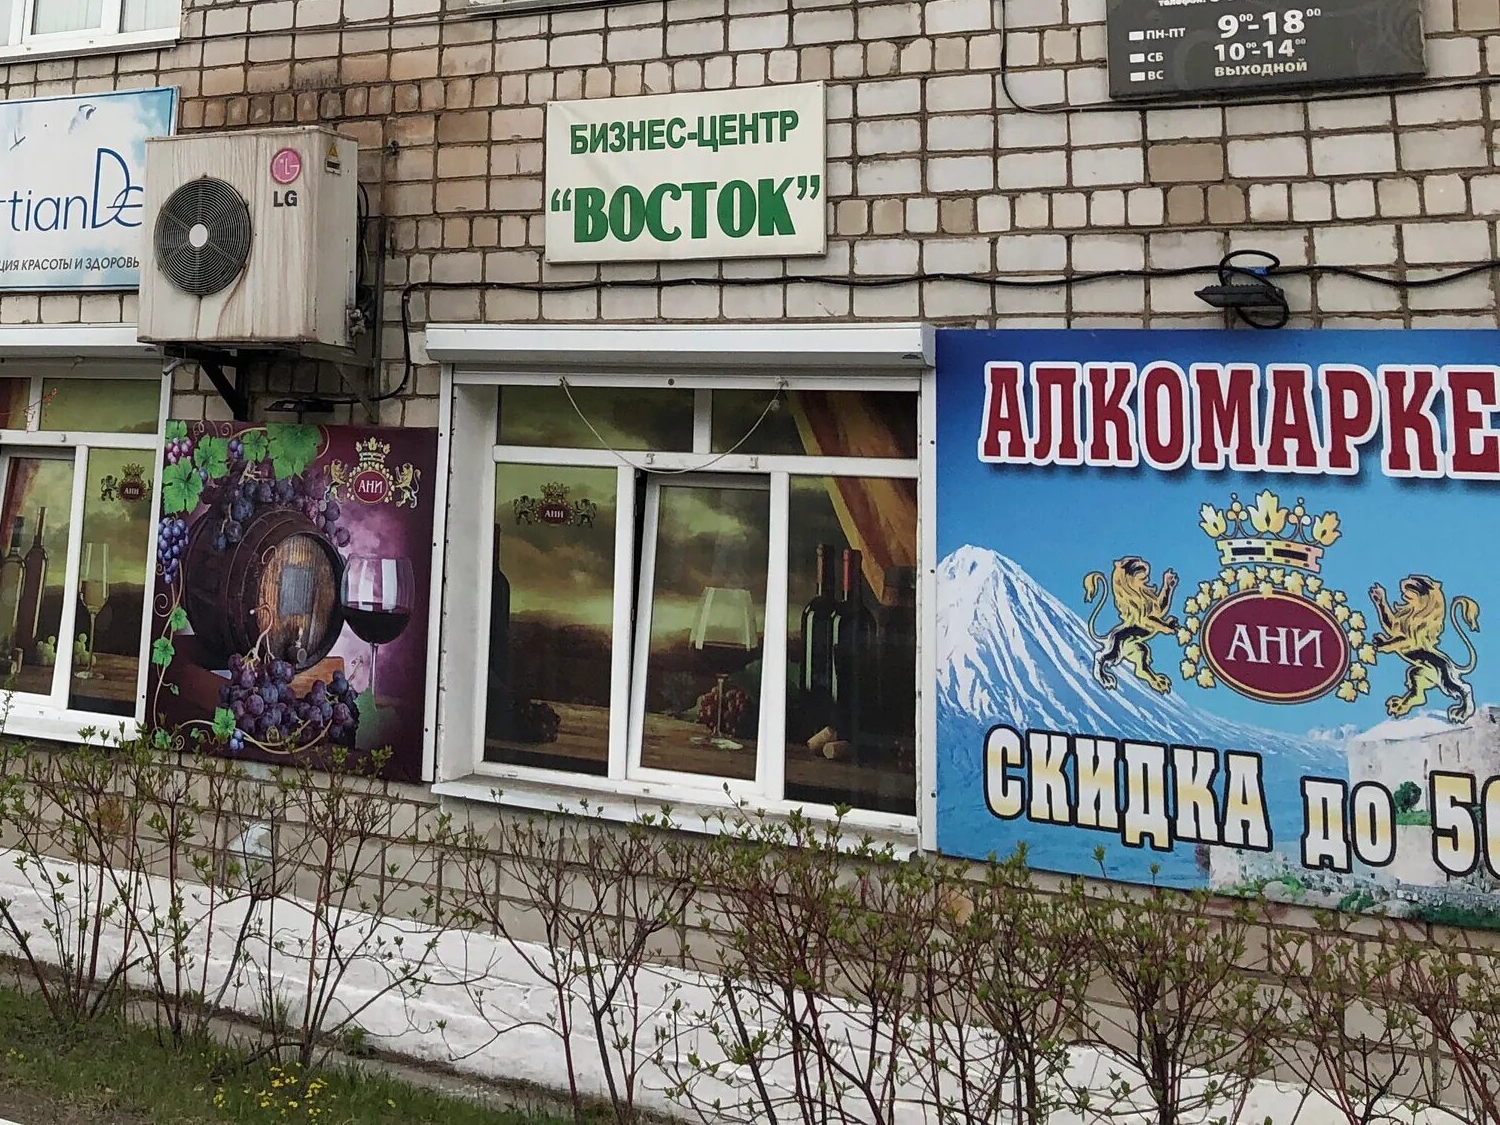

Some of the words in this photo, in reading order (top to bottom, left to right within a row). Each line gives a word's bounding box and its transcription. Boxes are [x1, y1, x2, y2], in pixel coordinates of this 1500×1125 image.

[1146, 27, 1186, 40] ПН-ПТ
[1147, 52, 1164, 63] СБ
[1147, 70, 1164, 81] ВС
[570, 110, 799, 155] БИЗНЕС-ЦЕНТР
[273, 189, 298, 208] LG
[21, 258, 72, 272] КРАСОТЫ
[74, 258, 83, 270] И
[978, 360, 1500, 480] АЛКОМАРКЕ
[358, 479, 384, 495] АНИ
[1224, 622, 1325, 669] АНИ
[982, 724, 1273, 853] СКИДКА
